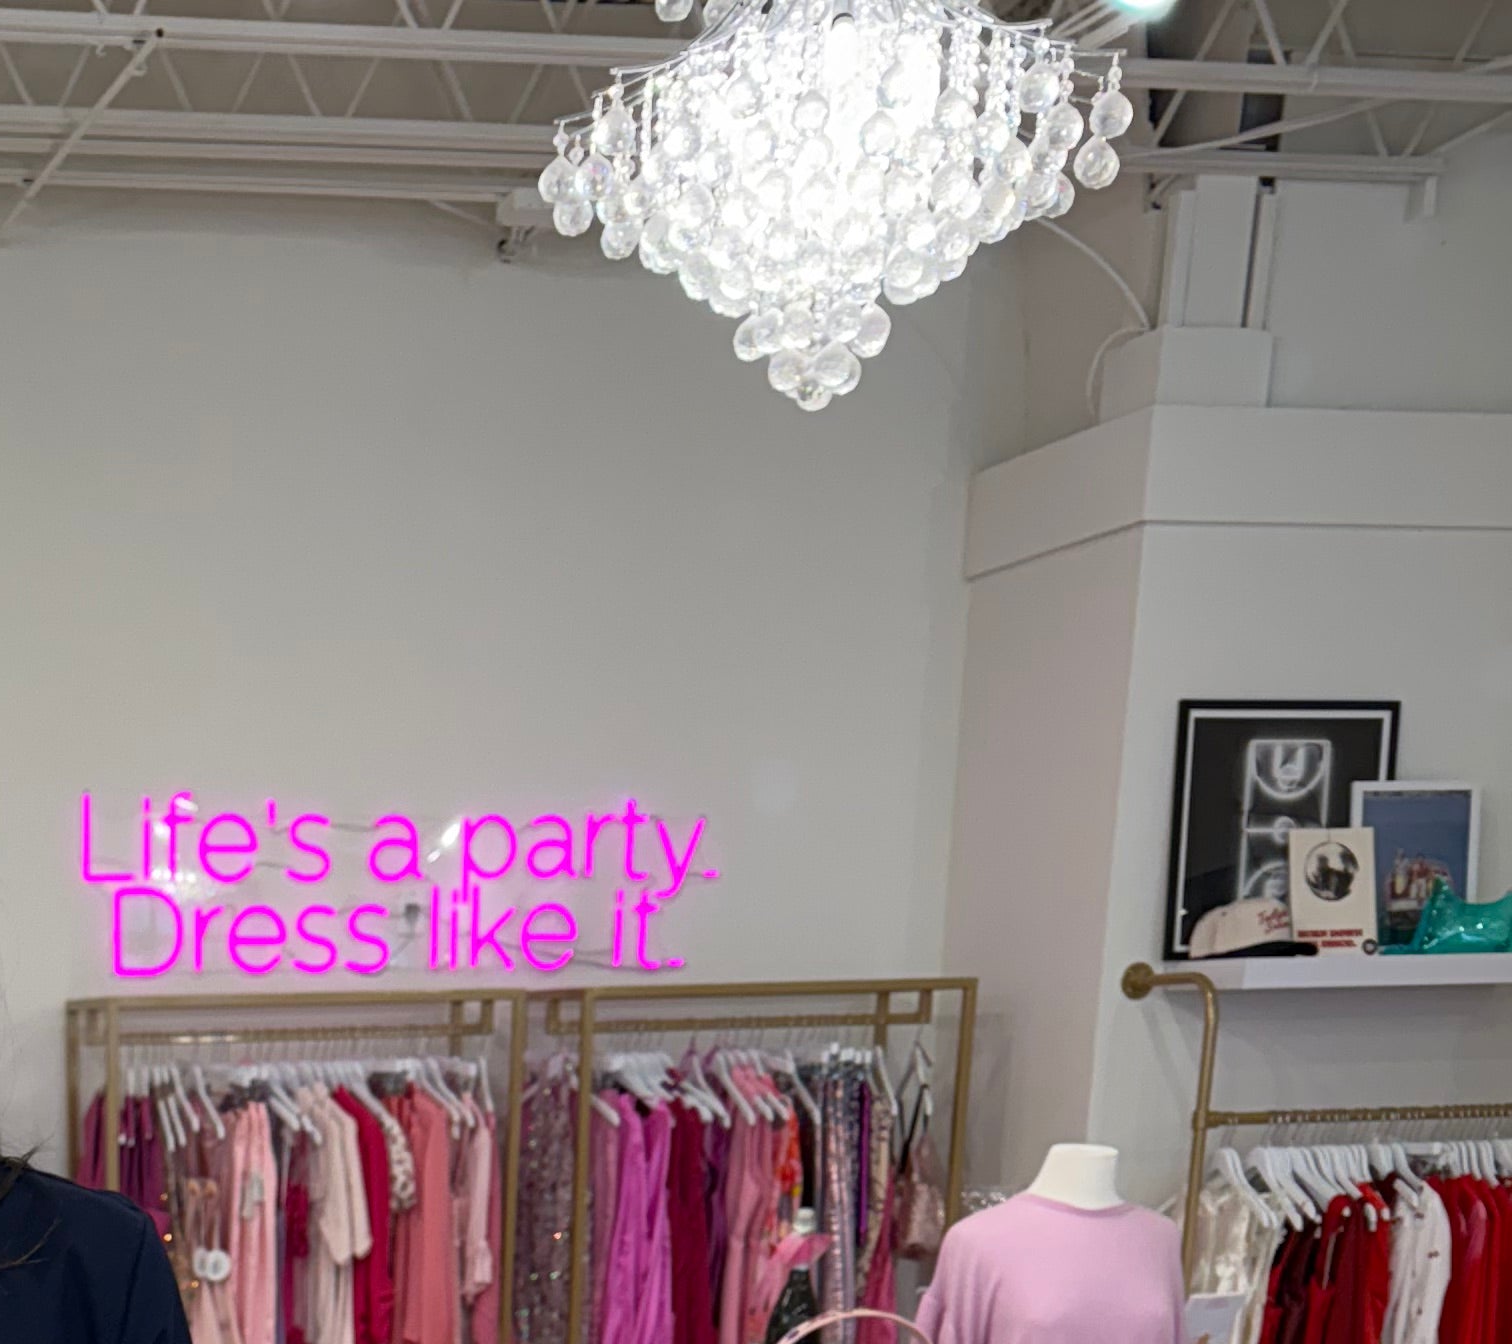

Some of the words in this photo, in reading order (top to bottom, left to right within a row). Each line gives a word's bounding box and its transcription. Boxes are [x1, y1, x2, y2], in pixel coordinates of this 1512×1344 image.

[82, 791, 331, 884] Life's
[368, 813, 423, 883] a
[460, 799, 719, 904] party.
[112, 885, 390, 977] Dress
[428, 884, 578, 973] like
[611, 889, 686, 970] it.
